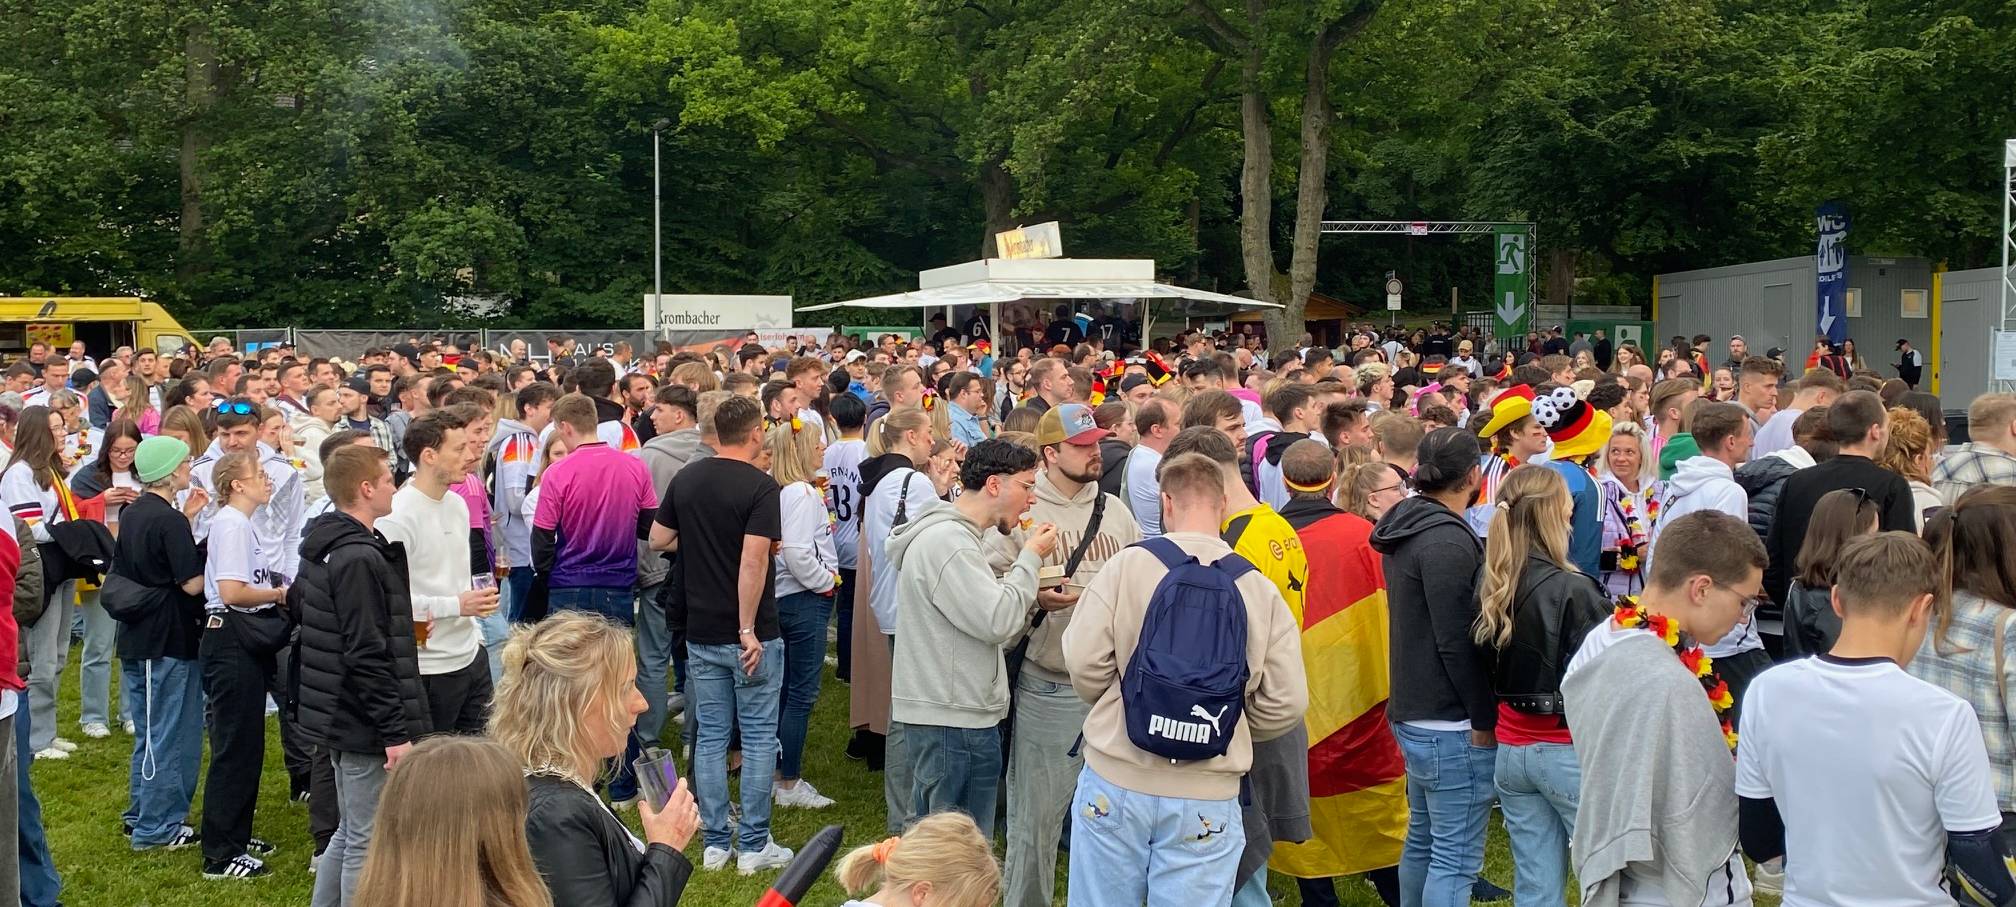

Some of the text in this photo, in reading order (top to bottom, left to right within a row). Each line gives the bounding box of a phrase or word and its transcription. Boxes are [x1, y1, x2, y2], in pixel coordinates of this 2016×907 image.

[973, 322, 982, 336] 6
[1062, 327, 1071, 342] 7
[1100, 324, 1113, 340] 17
[830, 484, 852, 521] 13
[1148, 714, 1211, 744] PUMA
